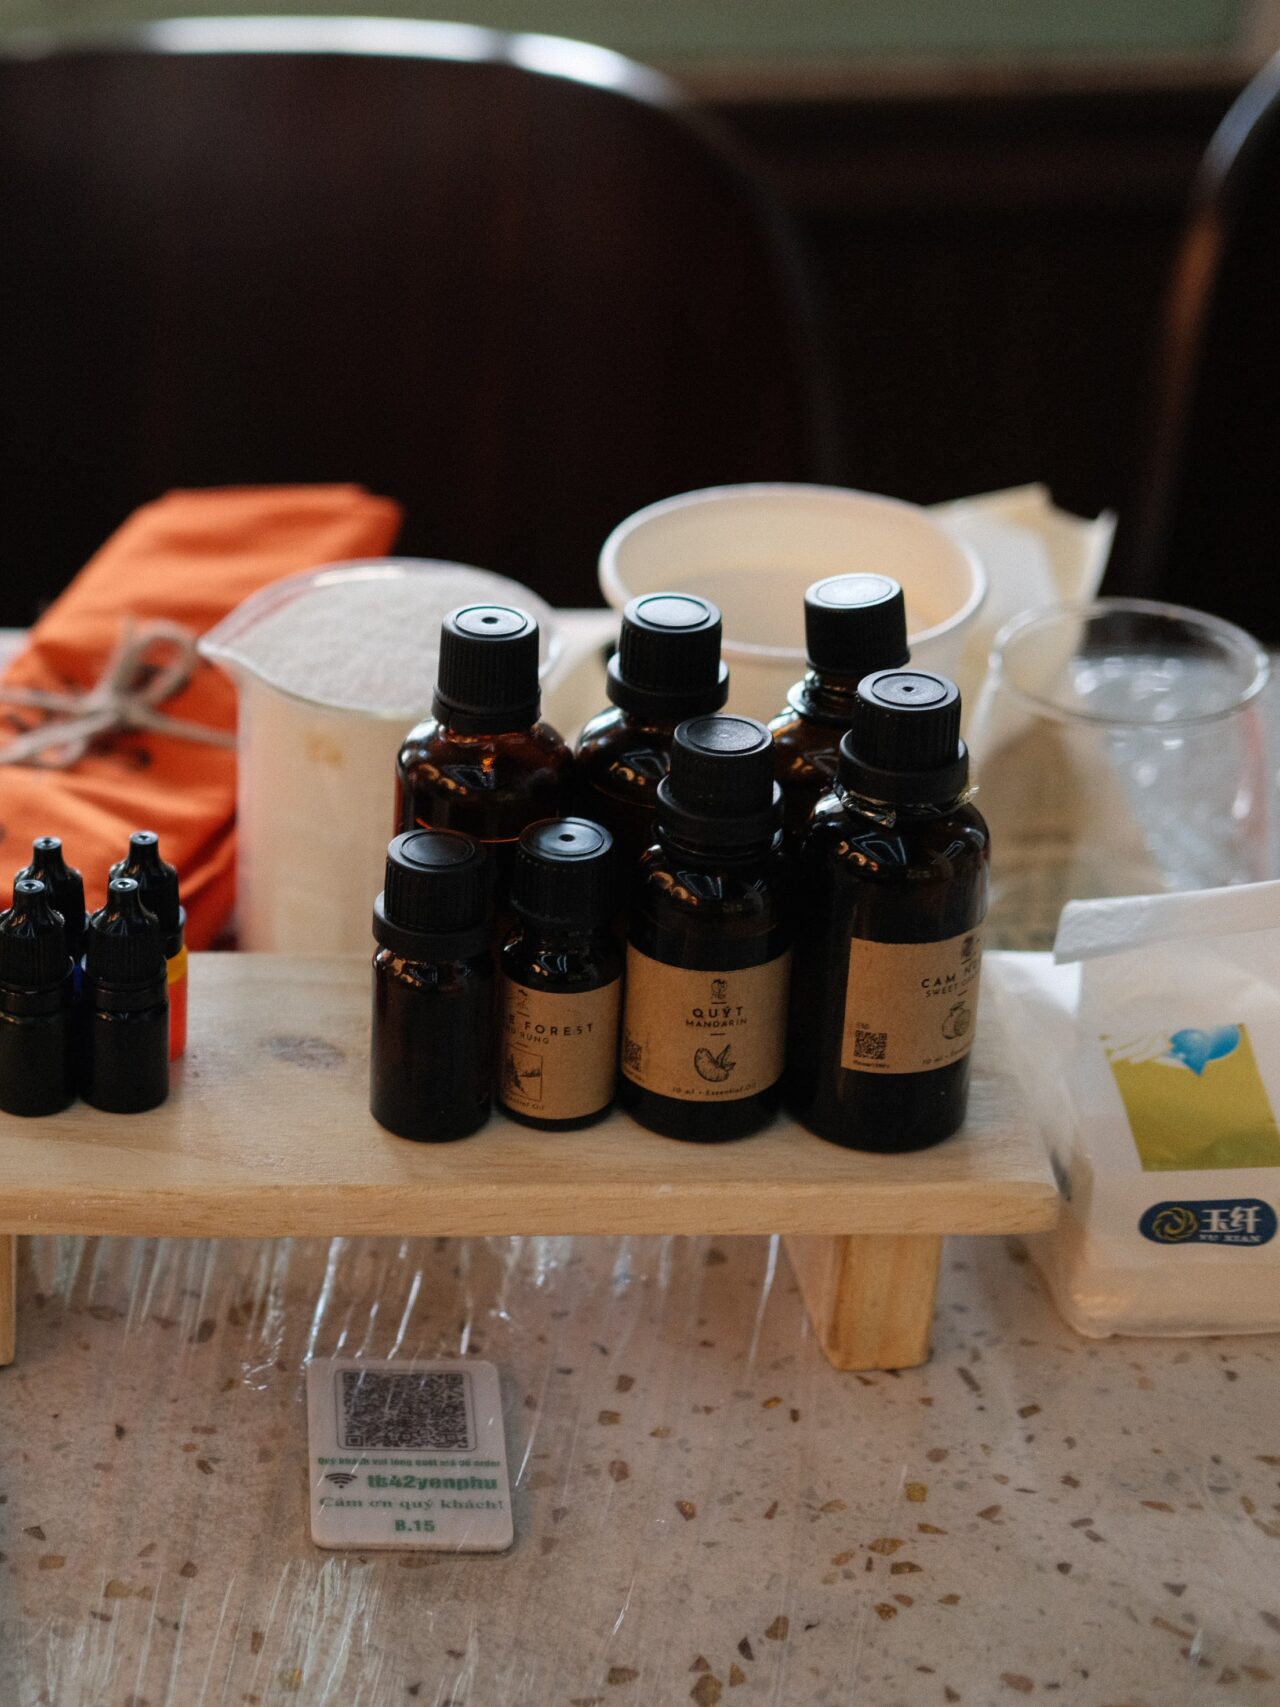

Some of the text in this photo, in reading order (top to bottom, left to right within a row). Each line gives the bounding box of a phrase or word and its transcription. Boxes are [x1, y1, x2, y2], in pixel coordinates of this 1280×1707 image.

[921, 973, 956, 988] CAM
[926, 983, 958, 998] SWEET
[524, 1021, 593, 1036] FOREST
[685, 1018, 747, 1028] MANDARIN
[395, 1519, 435, 1532] B.15
